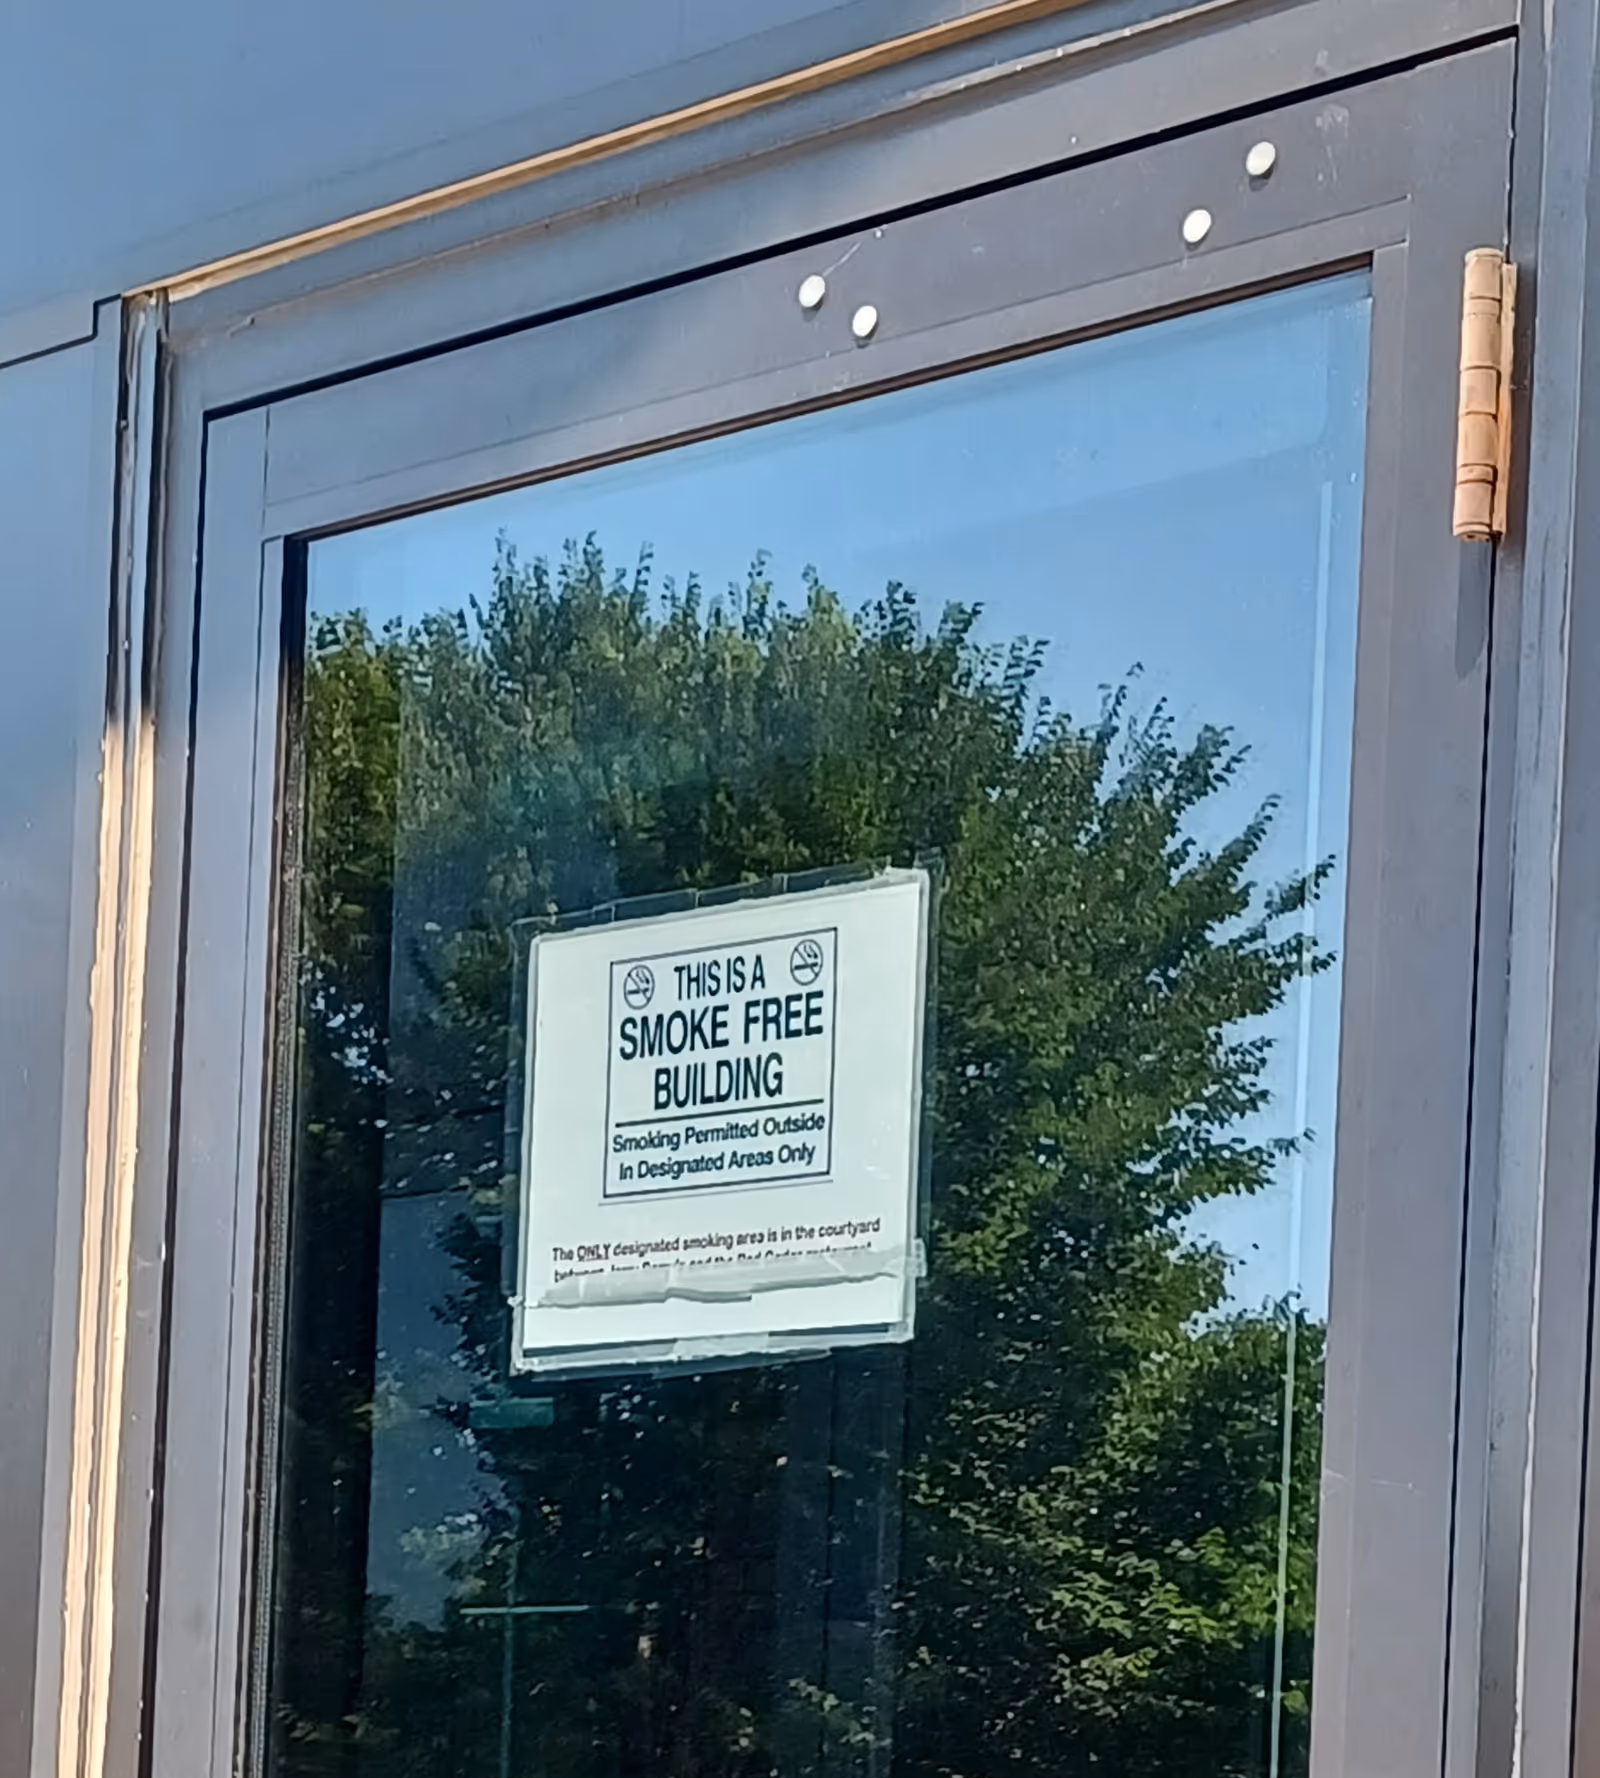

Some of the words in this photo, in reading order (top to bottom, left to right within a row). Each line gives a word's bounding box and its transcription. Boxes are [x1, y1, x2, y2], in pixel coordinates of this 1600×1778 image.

[674, 960, 721, 1001] THIS
[727, 956, 746, 994] IS
[751, 954, 766, 990] A
[619, 1004, 729, 1060] SMOKE
[743, 990, 824, 1044] FREE
[654, 1052, 783, 1110] BUILDING
[613, 1131, 681, 1153] Smoking
[685, 1120, 758, 1145] Permitted
[763, 1112, 825, 1136] Outside
[619, 1163, 633, 1180] In
[638, 1152, 725, 1180] Designated
[728, 1150, 773, 1169] Areas
[778, 1142, 816, 1165] Only
[552, 1247, 574, 1261] The
[577, 1243, 611, 1262] ONLY
[613, 1237, 680, 1258] designated
[683, 1232, 733, 1251] smoking
[736, 1232, 765, 1246] area
[767, 1227, 778, 1243] is
[781, 1225, 792, 1242] in
[795, 1225, 816, 1240] the
[818, 1217, 881, 1239] courtyard
